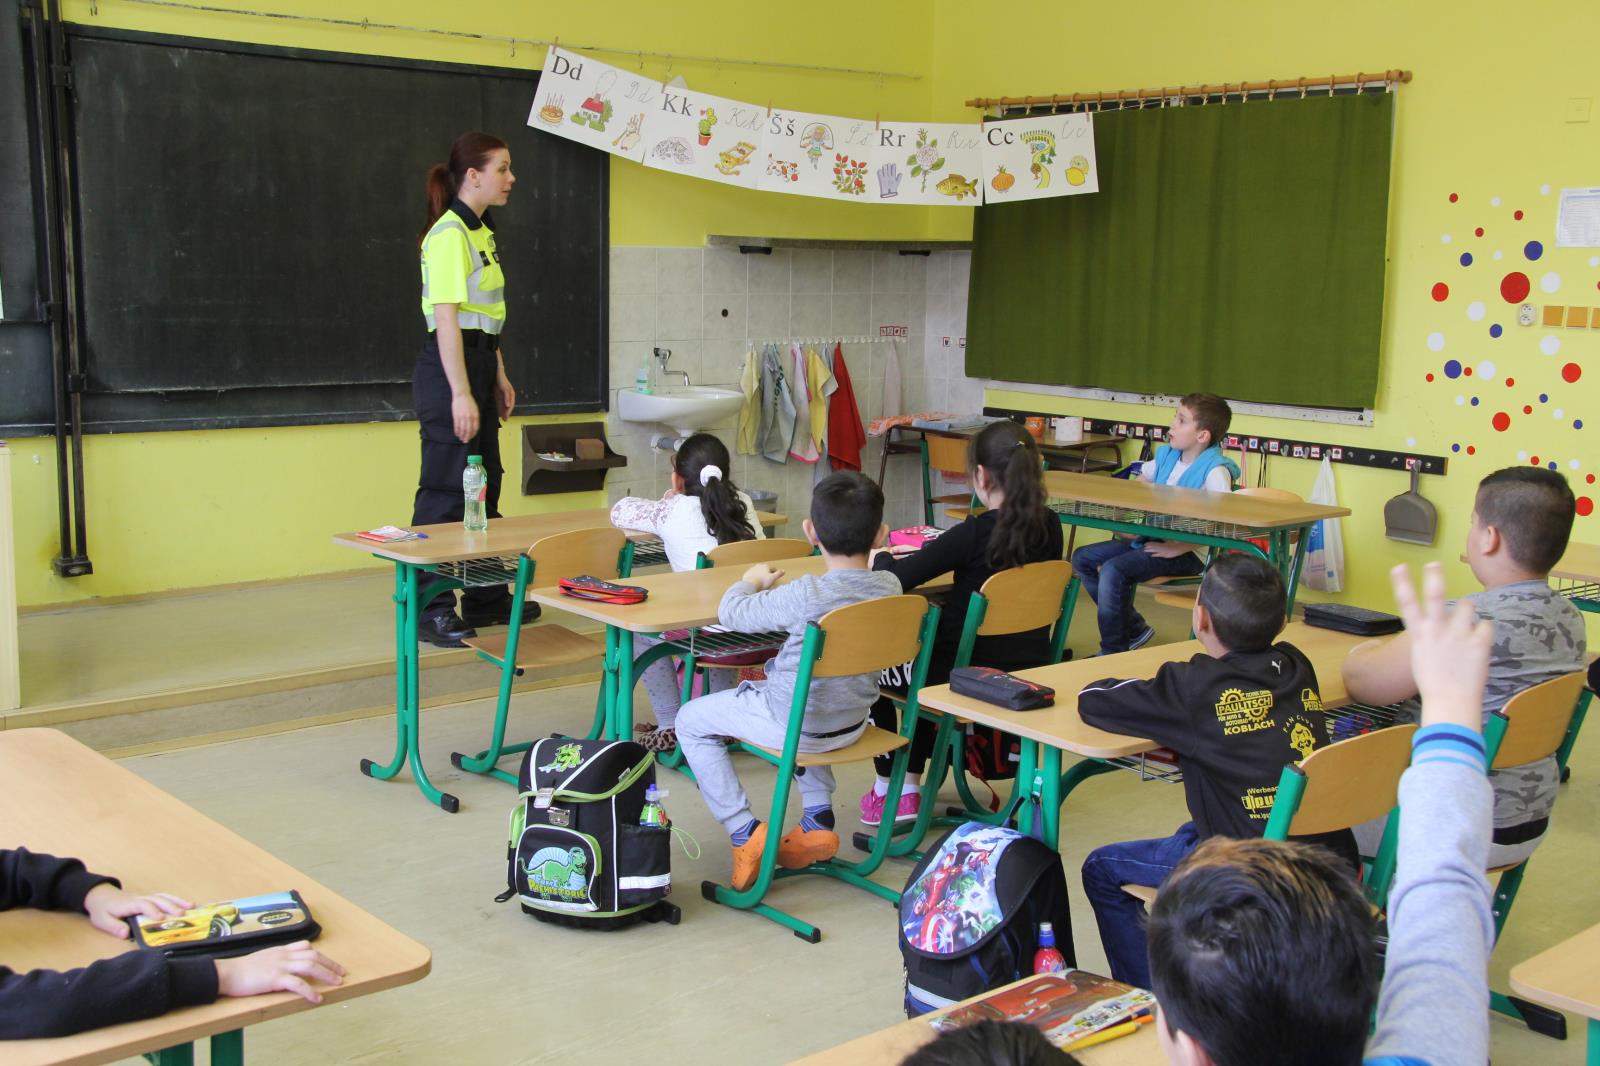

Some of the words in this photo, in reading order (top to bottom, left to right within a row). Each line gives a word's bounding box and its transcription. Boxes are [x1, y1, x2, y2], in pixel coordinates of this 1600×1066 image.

[551, 55, 583, 81] Dd
[662, 93, 693, 117] Kk
[770, 112, 796, 137] Šš
[880, 128, 906, 147] Rr
[987, 127, 1015, 147] Cc
[1219, 697, 1270, 714] PAULITSCH
[1224, 719, 1275, 735] KOBLACH
